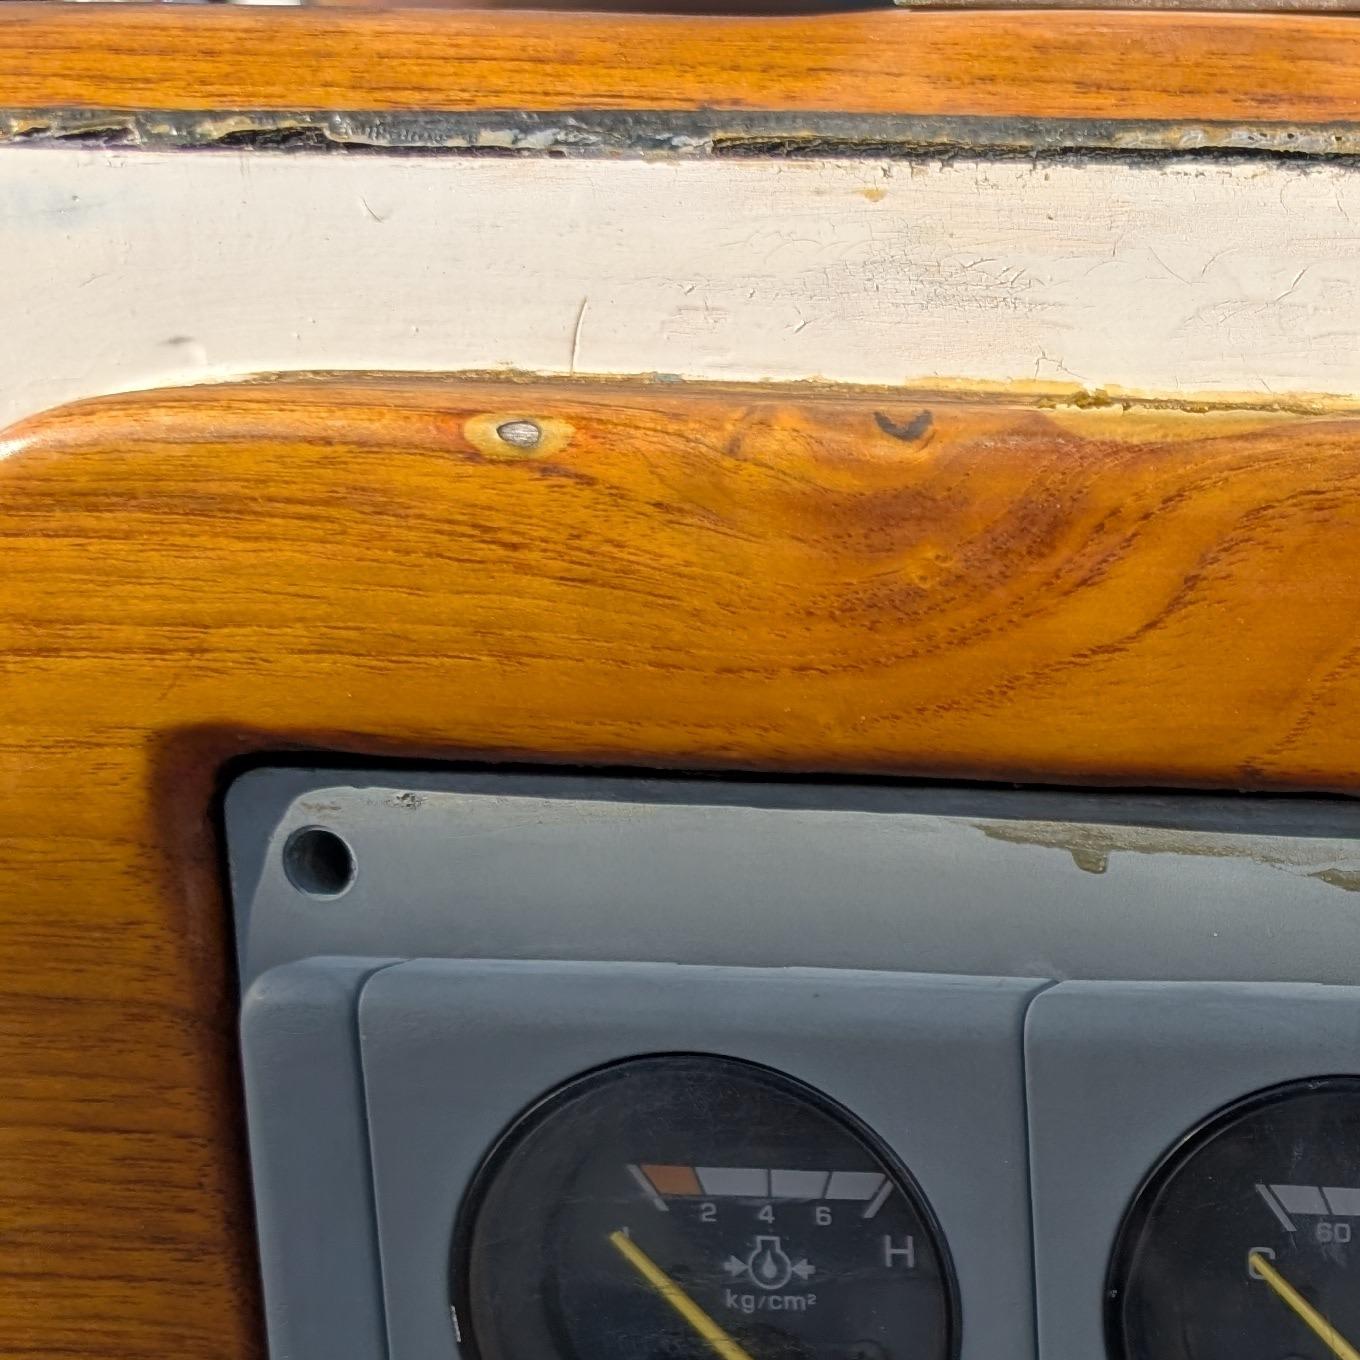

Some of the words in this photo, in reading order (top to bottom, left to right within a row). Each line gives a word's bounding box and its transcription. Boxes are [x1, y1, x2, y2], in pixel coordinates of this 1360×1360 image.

[701, 1204, 717, 1223] 2
[758, 1206, 775, 1224] 4
[815, 1207, 832, 1226] 6
[1316, 1223, 1351, 1244] 60
[885, 1234, 915, 1268] H
